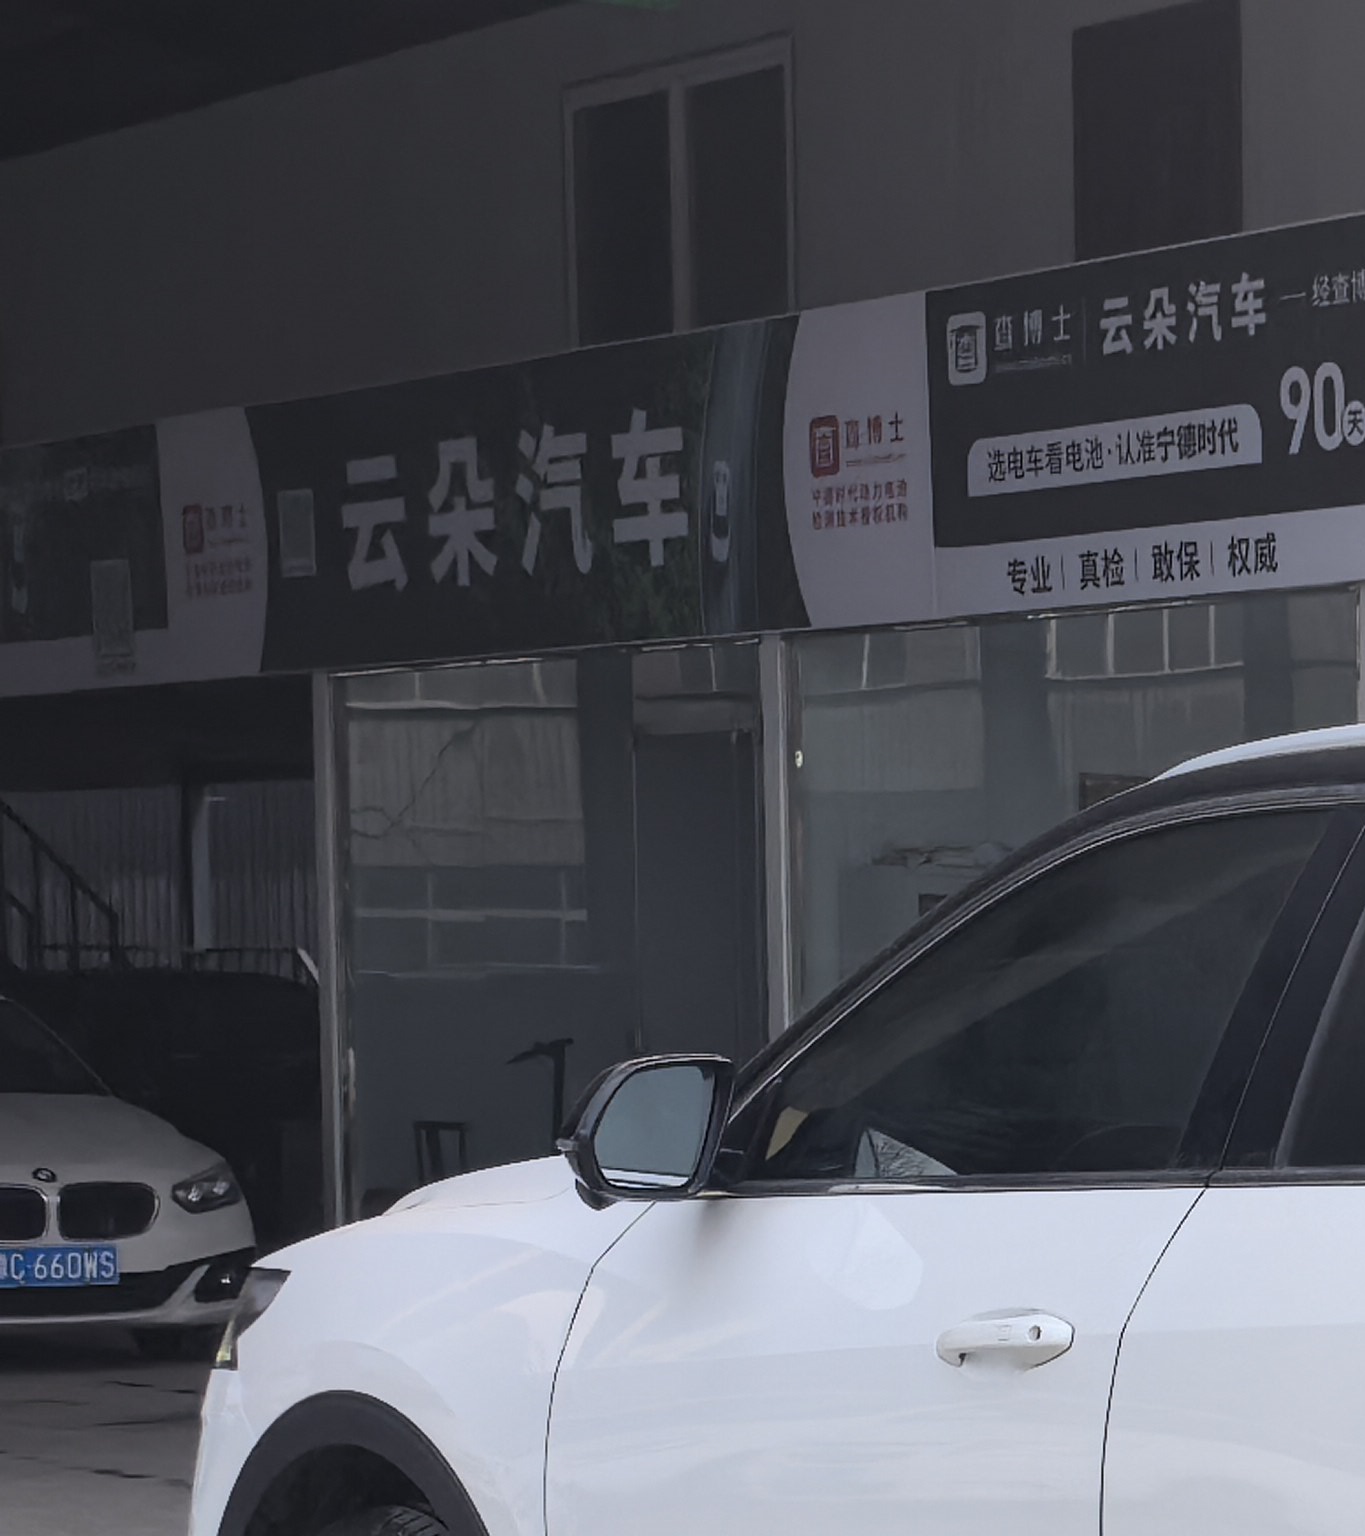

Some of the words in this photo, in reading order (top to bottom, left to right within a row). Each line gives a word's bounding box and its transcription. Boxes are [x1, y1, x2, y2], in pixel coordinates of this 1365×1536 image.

[1100, 272, 1267, 356] 云朵汽车
[341, 408, 689, 592] 云朵汽车
[1006, 556, 1053, 595] 专业
[1079, 548, 1125, 590] 真检
[1152, 540, 1201, 583] 敢保
[1227, 532, 1279, 578] 权威
